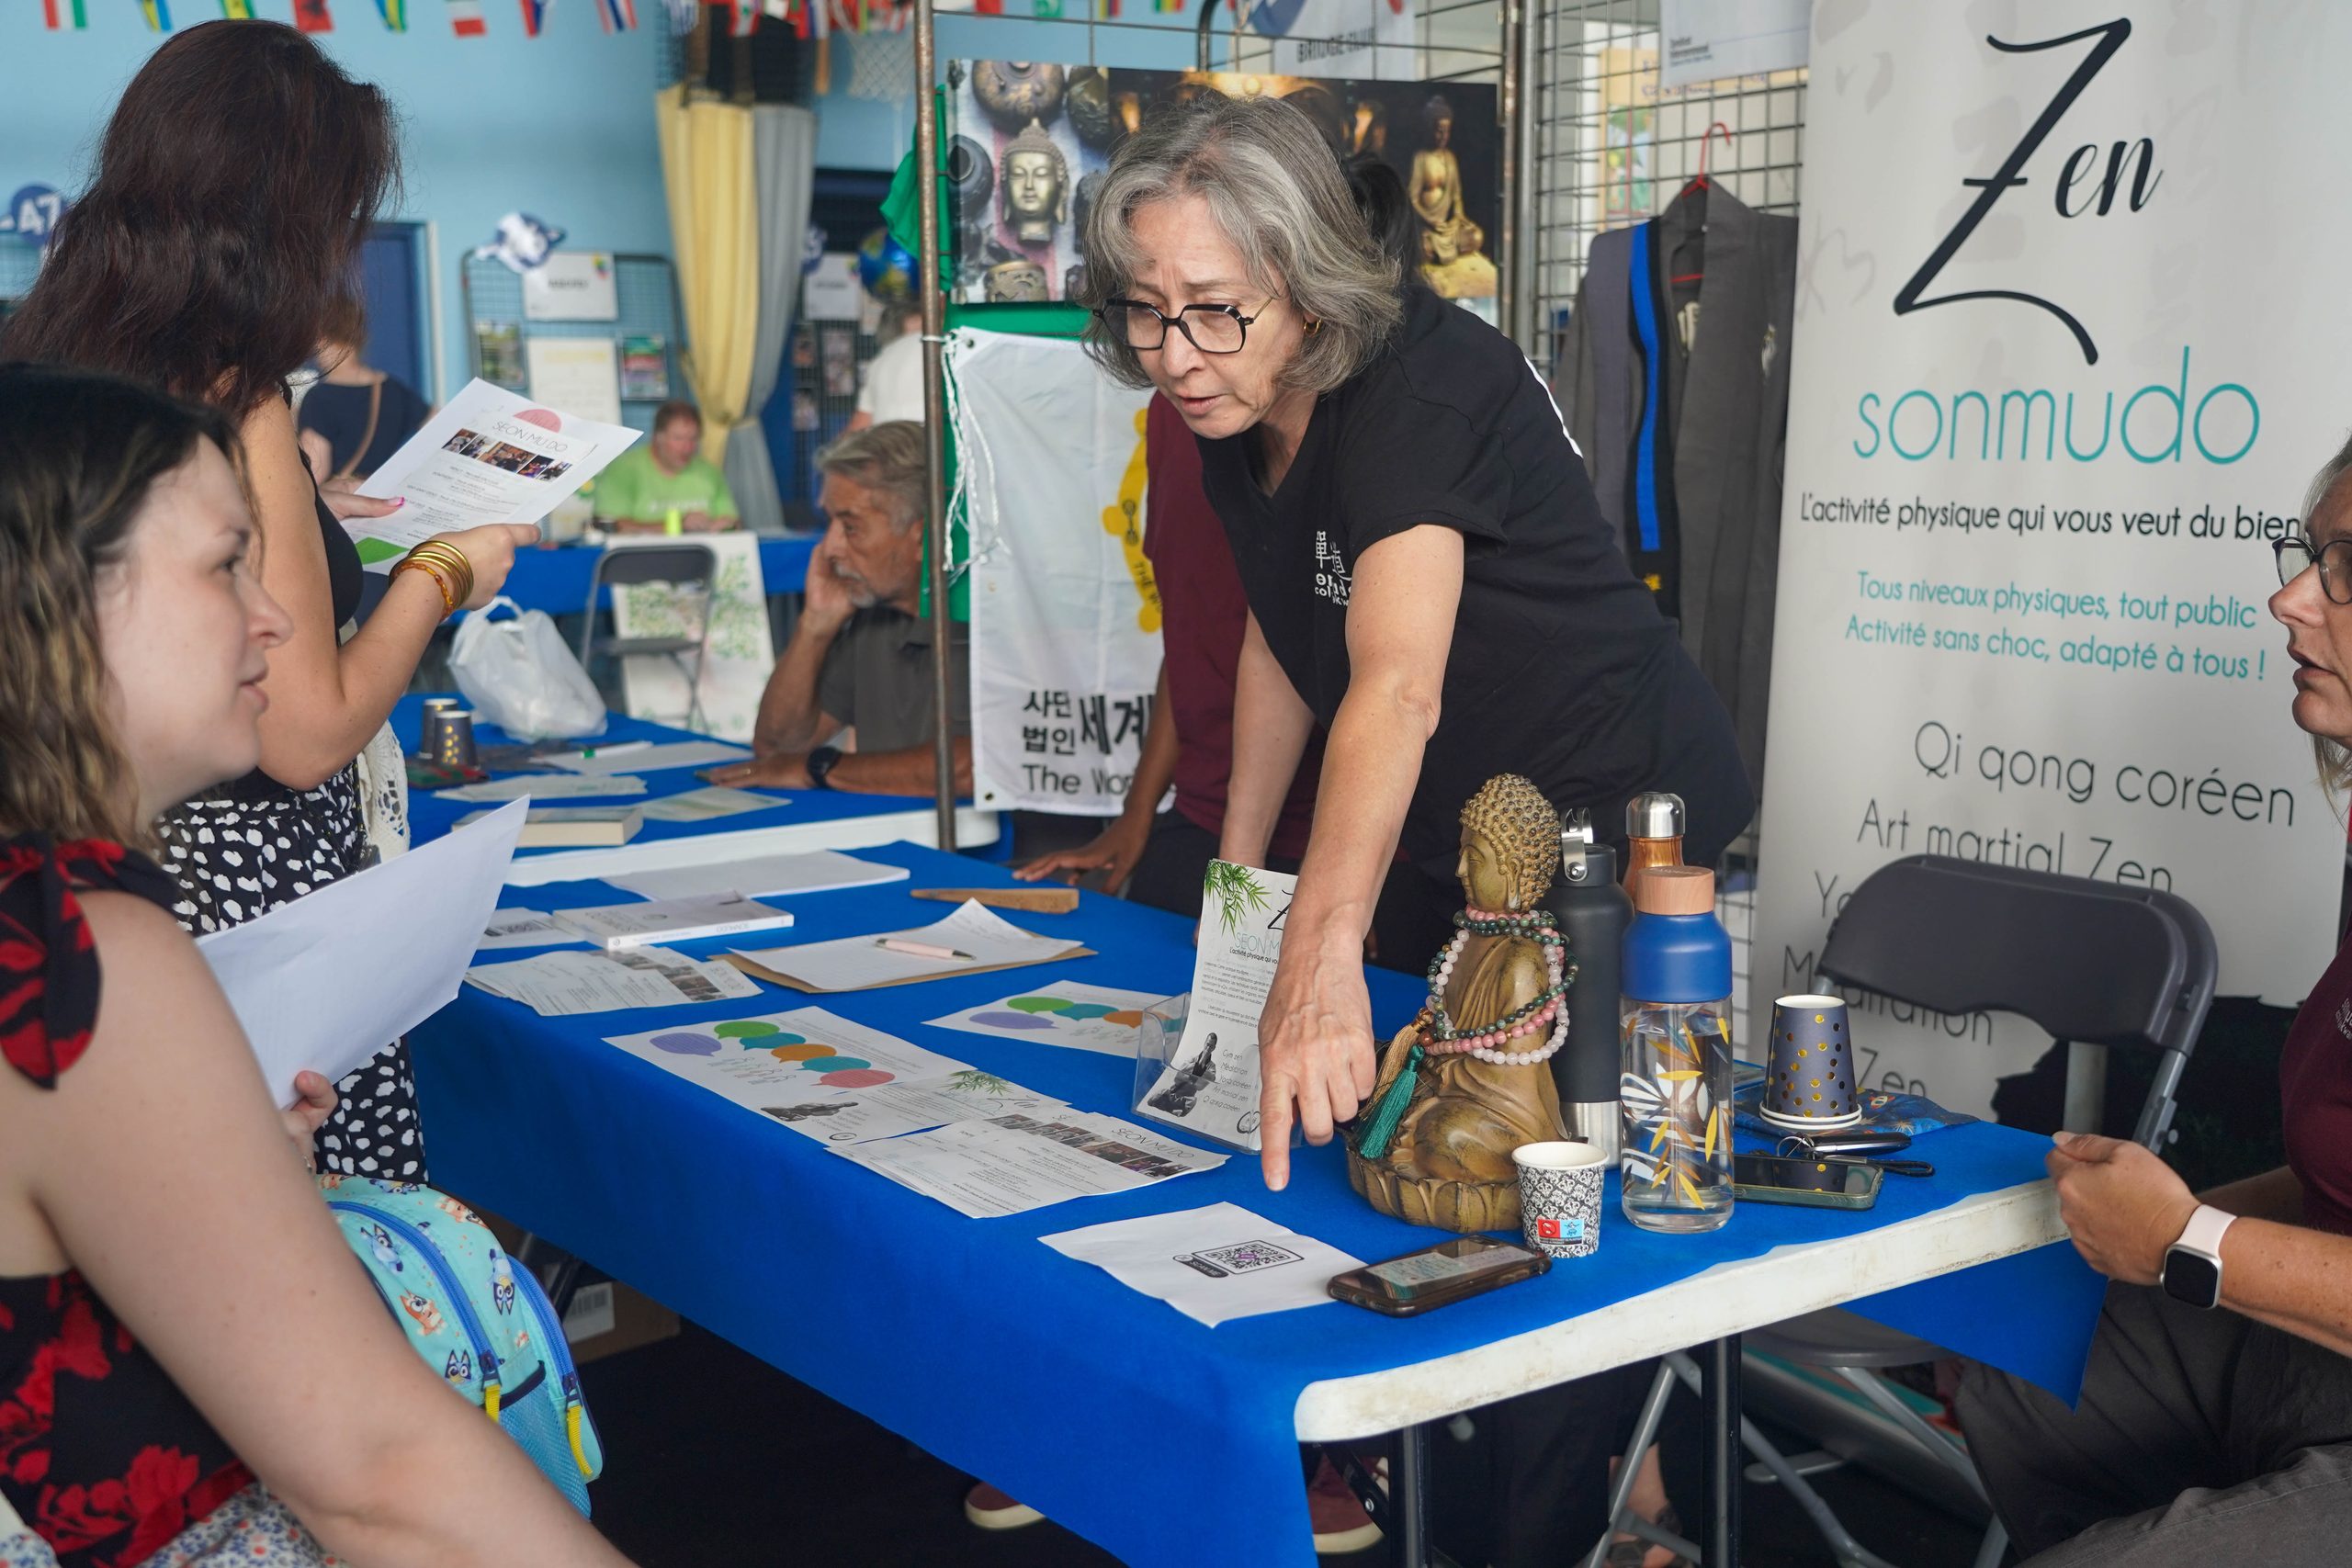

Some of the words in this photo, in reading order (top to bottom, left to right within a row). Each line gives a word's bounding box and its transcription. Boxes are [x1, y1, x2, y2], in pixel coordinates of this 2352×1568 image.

[1894, 18, 2163, 366] Zen
[1854, 345, 2260, 464] sonmudo
[1800, 491, 1890, 524] L'activité
[1897, 496, 2000, 534] physique
[2007, 504, 2045, 536] qui
[2053, 510, 2112, 533] vous
[2122, 507, 2180, 535] veut
[2190, 504, 2224, 538] du
[1858, 571, 1902, 600] Tous
[1910, 580, 1988, 606] niveaux
[1994, 581, 2109, 620] physiques,
[2120, 592, 2167, 620] tout
[2176, 594, 2256, 628] public
[1845, 614, 1926, 647] Activité
[1933, 628, 1980, 652] sans
[1987, 626, 2050, 662] choc,
[2060, 635, 2157, 671] adapté
[2166, 645, 2184, 671] à
[2193, 647, 2248, 678] tous
[1022, 764, 1081, 795] The
[1915, 721, 1962, 779] Qi
[2117, 765, 2295, 827] coréen
[1857, 798, 1909, 851] Art
[1927, 825, 2064, 874] martial
[2089, 837, 2173, 894] Zen
[1858, 1046, 1927, 1097] Zen
